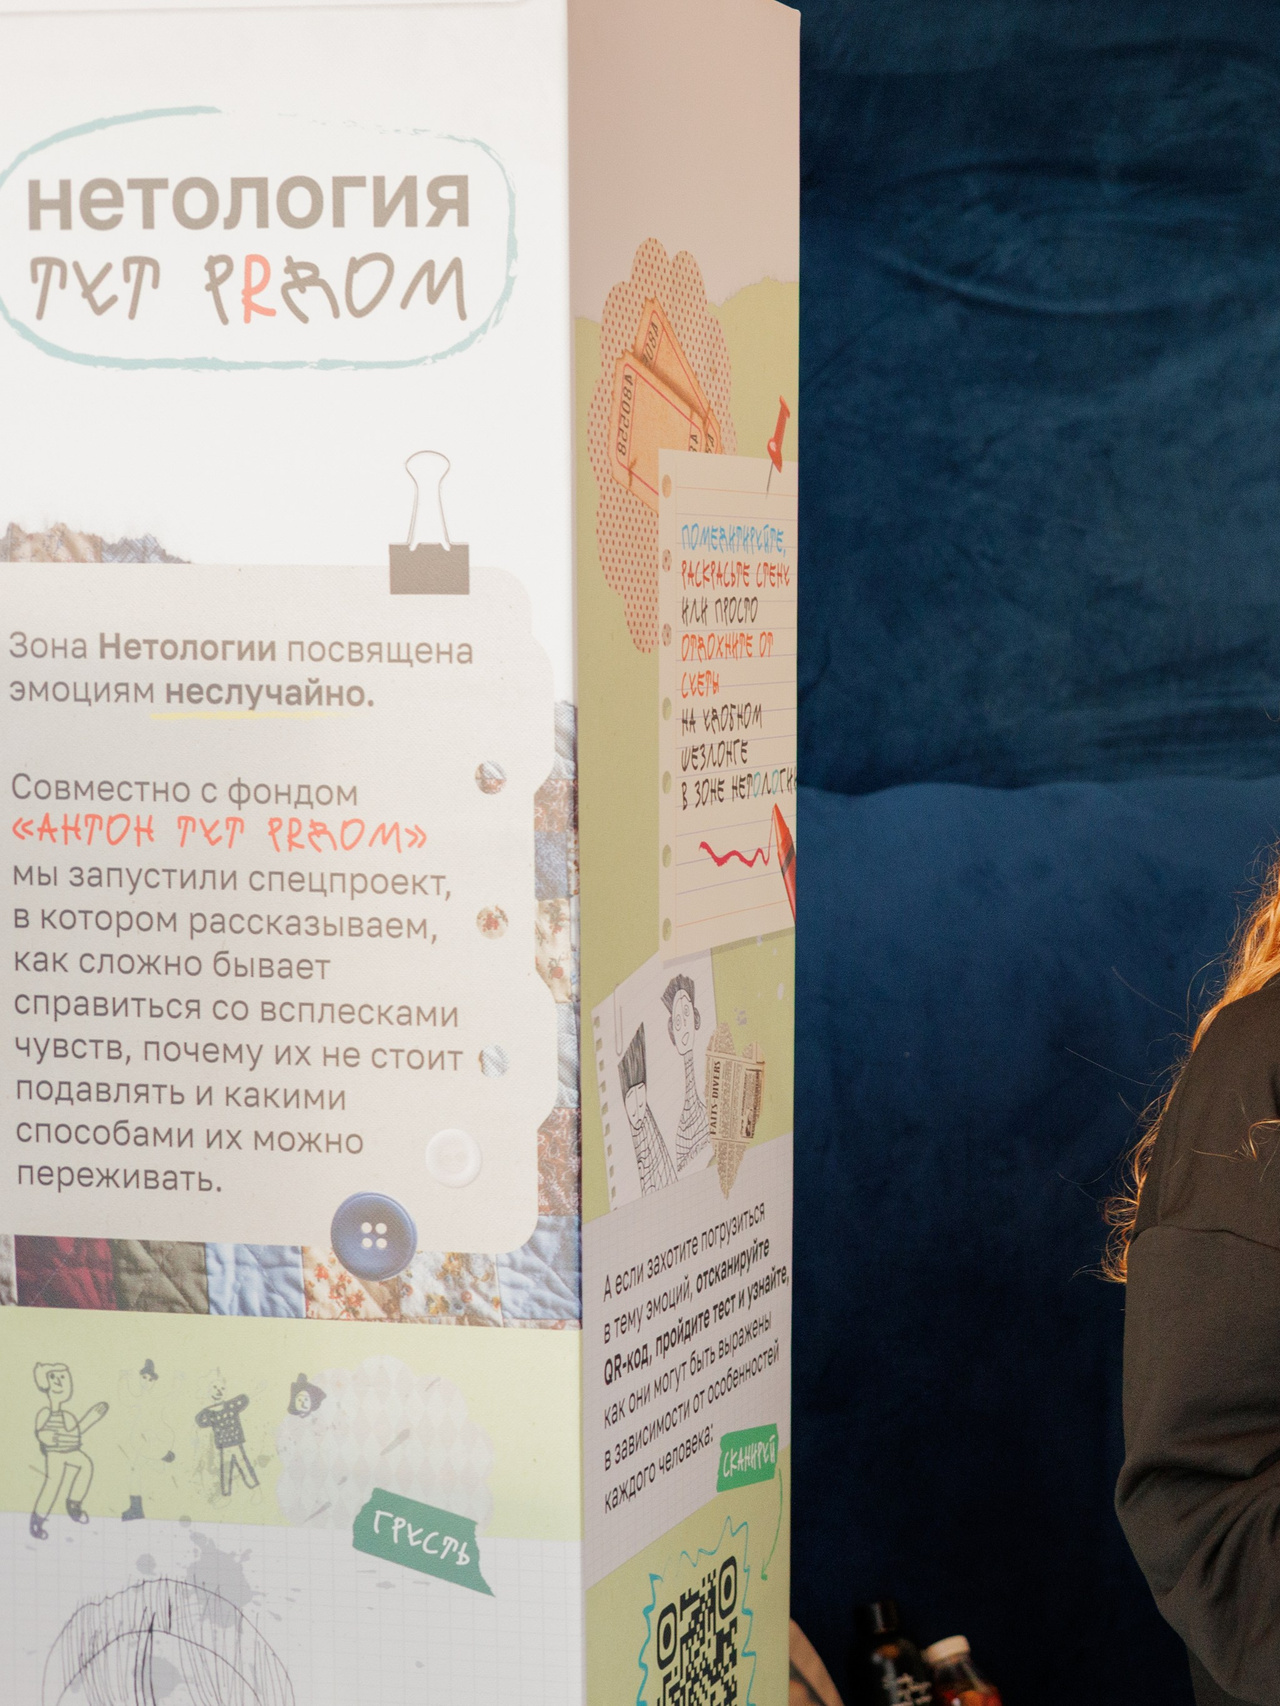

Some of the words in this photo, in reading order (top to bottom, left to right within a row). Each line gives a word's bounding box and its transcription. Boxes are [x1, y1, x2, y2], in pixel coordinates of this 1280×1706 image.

[27, 174, 470, 231] нетология
[681, 559, 750, 590] РАСКРАСЬТЕ
[756, 561, 790, 589] СТЕНУ
[681, 596, 708, 626] ИЛИ
[715, 596, 759, 626] ПРОСТО
[9, 632, 87, 660] Зона
[99, 633, 277, 662] Нетологии
[287, 638, 473, 668] посвящена
[681, 632, 753, 663] ОТДОХНИТЕ
[759, 631, 774, 658] ОТ
[9, 680, 155, 707] эмоциям
[165, 678, 375, 711] неслучайно.
[681, 669, 720, 699] СУЕТЫ
[681, 707, 696, 736] НА
[703, 702, 763, 735] УДОБНОМ
[681, 738, 749, 772] ШЕЗЛОНГЕ
[11, 773, 190, 803] Совместно
[201, 781, 217, 803] с
[228, 777, 358, 811] фондом
[681, 781, 688, 811] В
[694, 778, 725, 809] ЗОНЕ
[732, 766, 797, 802] НЕТОЛОГИ
[13, 864, 58, 888] мы
[69, 864, 238, 896] запустили
[248, 867, 452, 901] спецпроект,
[14, 908, 30, 929] в
[40, 907, 178, 939] котором
[188, 908, 439, 945] рассказываем,
[14, 950, 69, 974] как
[79, 953, 203, 977] сложно
[212, 950, 331, 980] бывает
[14, 992, 202, 1023] справиться
[212, 998, 250, 1021] со
[260, 1000, 460, 1029] всплесками
[15, 1035, 132, 1066] чувств,
[143, 1037, 263, 1071] почему
[274, 1043, 311, 1067] их
[322, 1046, 361, 1069] не
[370, 1048, 463, 1072] стоит
[16, 1078, 186, 1108] подавлять
[196, 1084, 214, 1107] и
[225, 1086, 347, 1111] какими
[16, 1119, 194, 1150] способами
[205, 1127, 243, 1151] их
[254, 1128, 364, 1155] можно
[17, 1162, 223, 1194] переживать.
[603, 1274, 613, 1303] А
[615, 1262, 645, 1294] если
[647, 1236, 699, 1281] захотите
[701, 1202, 766, 1253] погрузиться
[604, 1321, 612, 1345] в
[614, 1305, 644, 1335] тему
[646, 1274, 694, 1322] эмоций,
[696, 1237, 771, 1295] отсканируйте
[604, 1347, 653, 1387] QR-код,
[655, 1312, 710, 1353] пройдите
[712, 1296, 736, 1324] тест
[738, 1287, 746, 1306] и
[747, 1264, 790, 1307] узнайте,
[604, 1397, 626, 1429] как
[628, 1383, 651, 1412] они
[653, 1360, 687, 1399] могут
[690, 1347, 716, 1377] быть
[718, 1310, 772, 1359] выражены
[604, 1449, 612, 1471] в
[614, 1401, 690, 1465] зависимости
[693, 1391, 705, 1415] от
[707, 1338, 780, 1404] особенностей
[604, 1467, 657, 1514] каждого
[658, 1423, 714, 1473] человека:
[722, 1434, 777, 1478] СКАНИРУЙ
[373, 1509, 471, 1566] ГРУСТЬ
